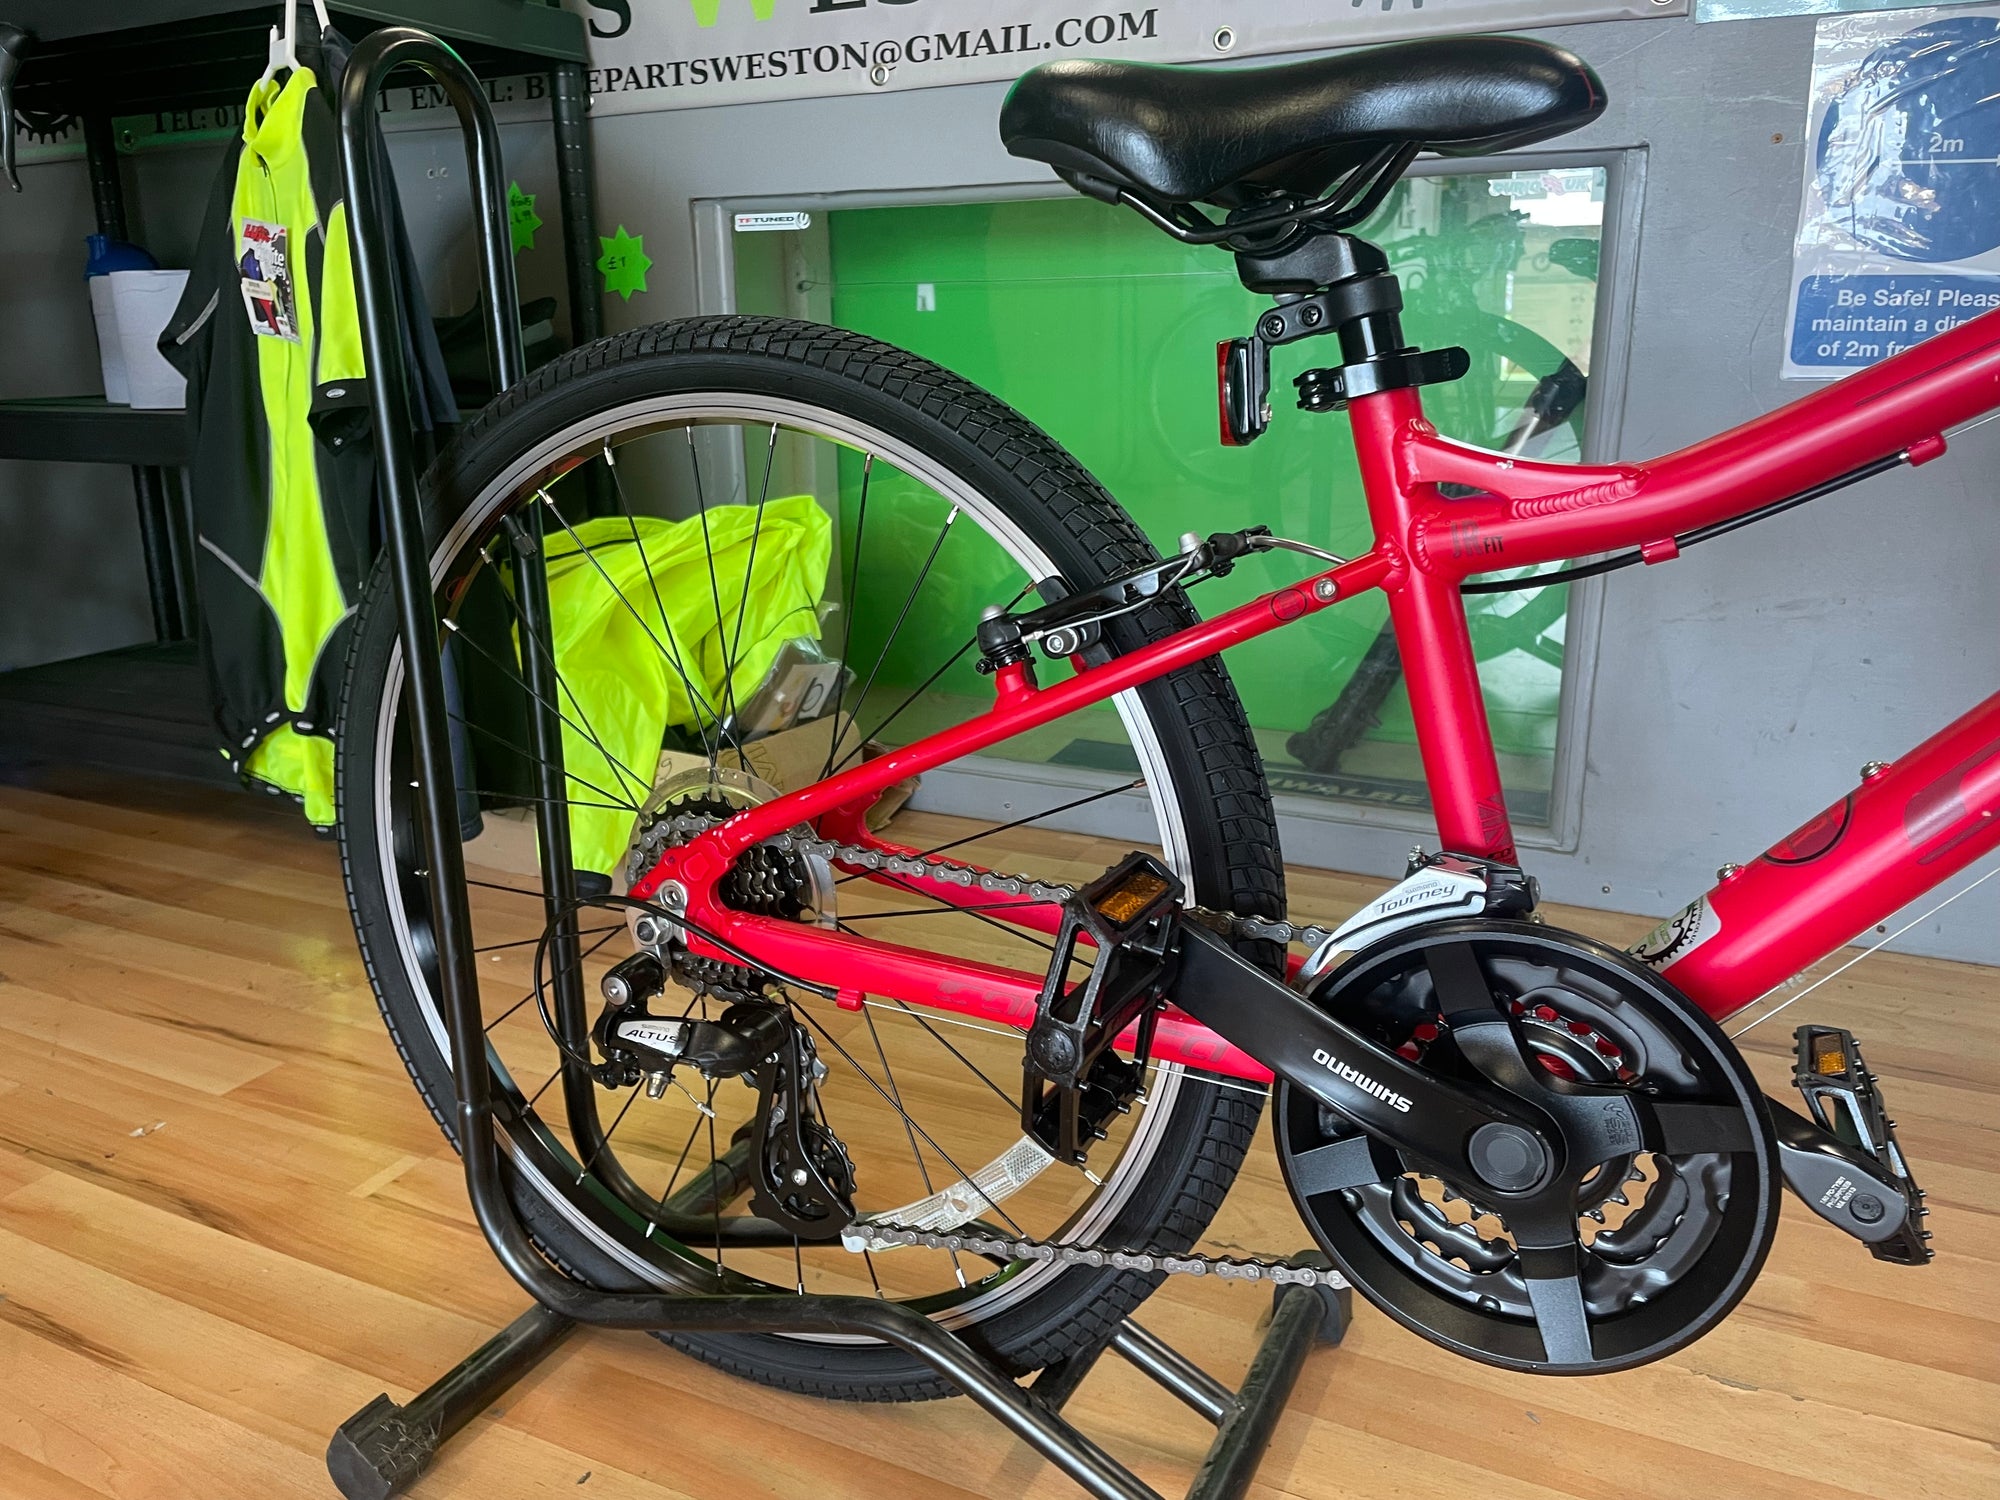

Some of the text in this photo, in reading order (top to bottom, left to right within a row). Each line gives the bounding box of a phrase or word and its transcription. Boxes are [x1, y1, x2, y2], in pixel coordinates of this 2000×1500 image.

[1928, 132, 1964, 153] 2m
[1837, 289, 2000, 308] Be Safe! Pleas
[1812, 315, 1907, 332] maintain
[1913, 318, 1928, 332] a
[1817, 341, 1841, 357] of
[1845, 341, 1879, 357] 2m
[1483, 535, 1504, 554] FIT
[1376, 884, 1456, 914] Tourney
[625, 1029, 678, 1044] ALTUS
[1312, 1048, 1413, 1113] SHIMANO
